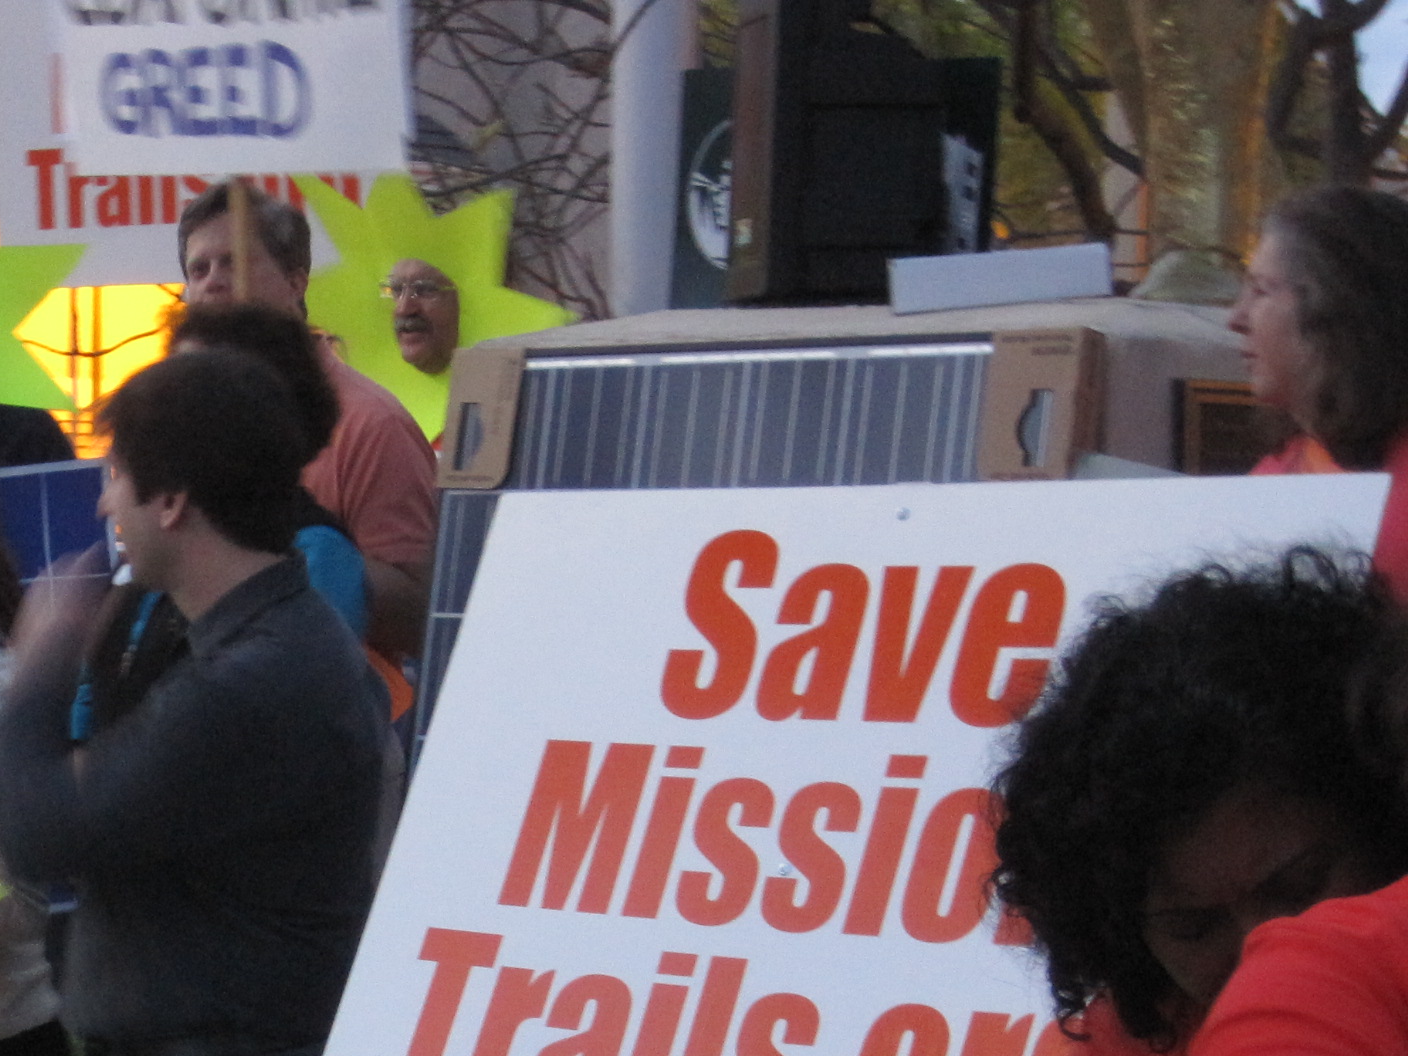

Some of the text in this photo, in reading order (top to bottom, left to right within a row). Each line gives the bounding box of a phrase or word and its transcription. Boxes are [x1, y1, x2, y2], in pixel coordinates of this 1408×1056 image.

[100, 40, 310, 137] GREED
[659, 529, 1066, 728] Save
[496, 739, 1035, 945] Missio
